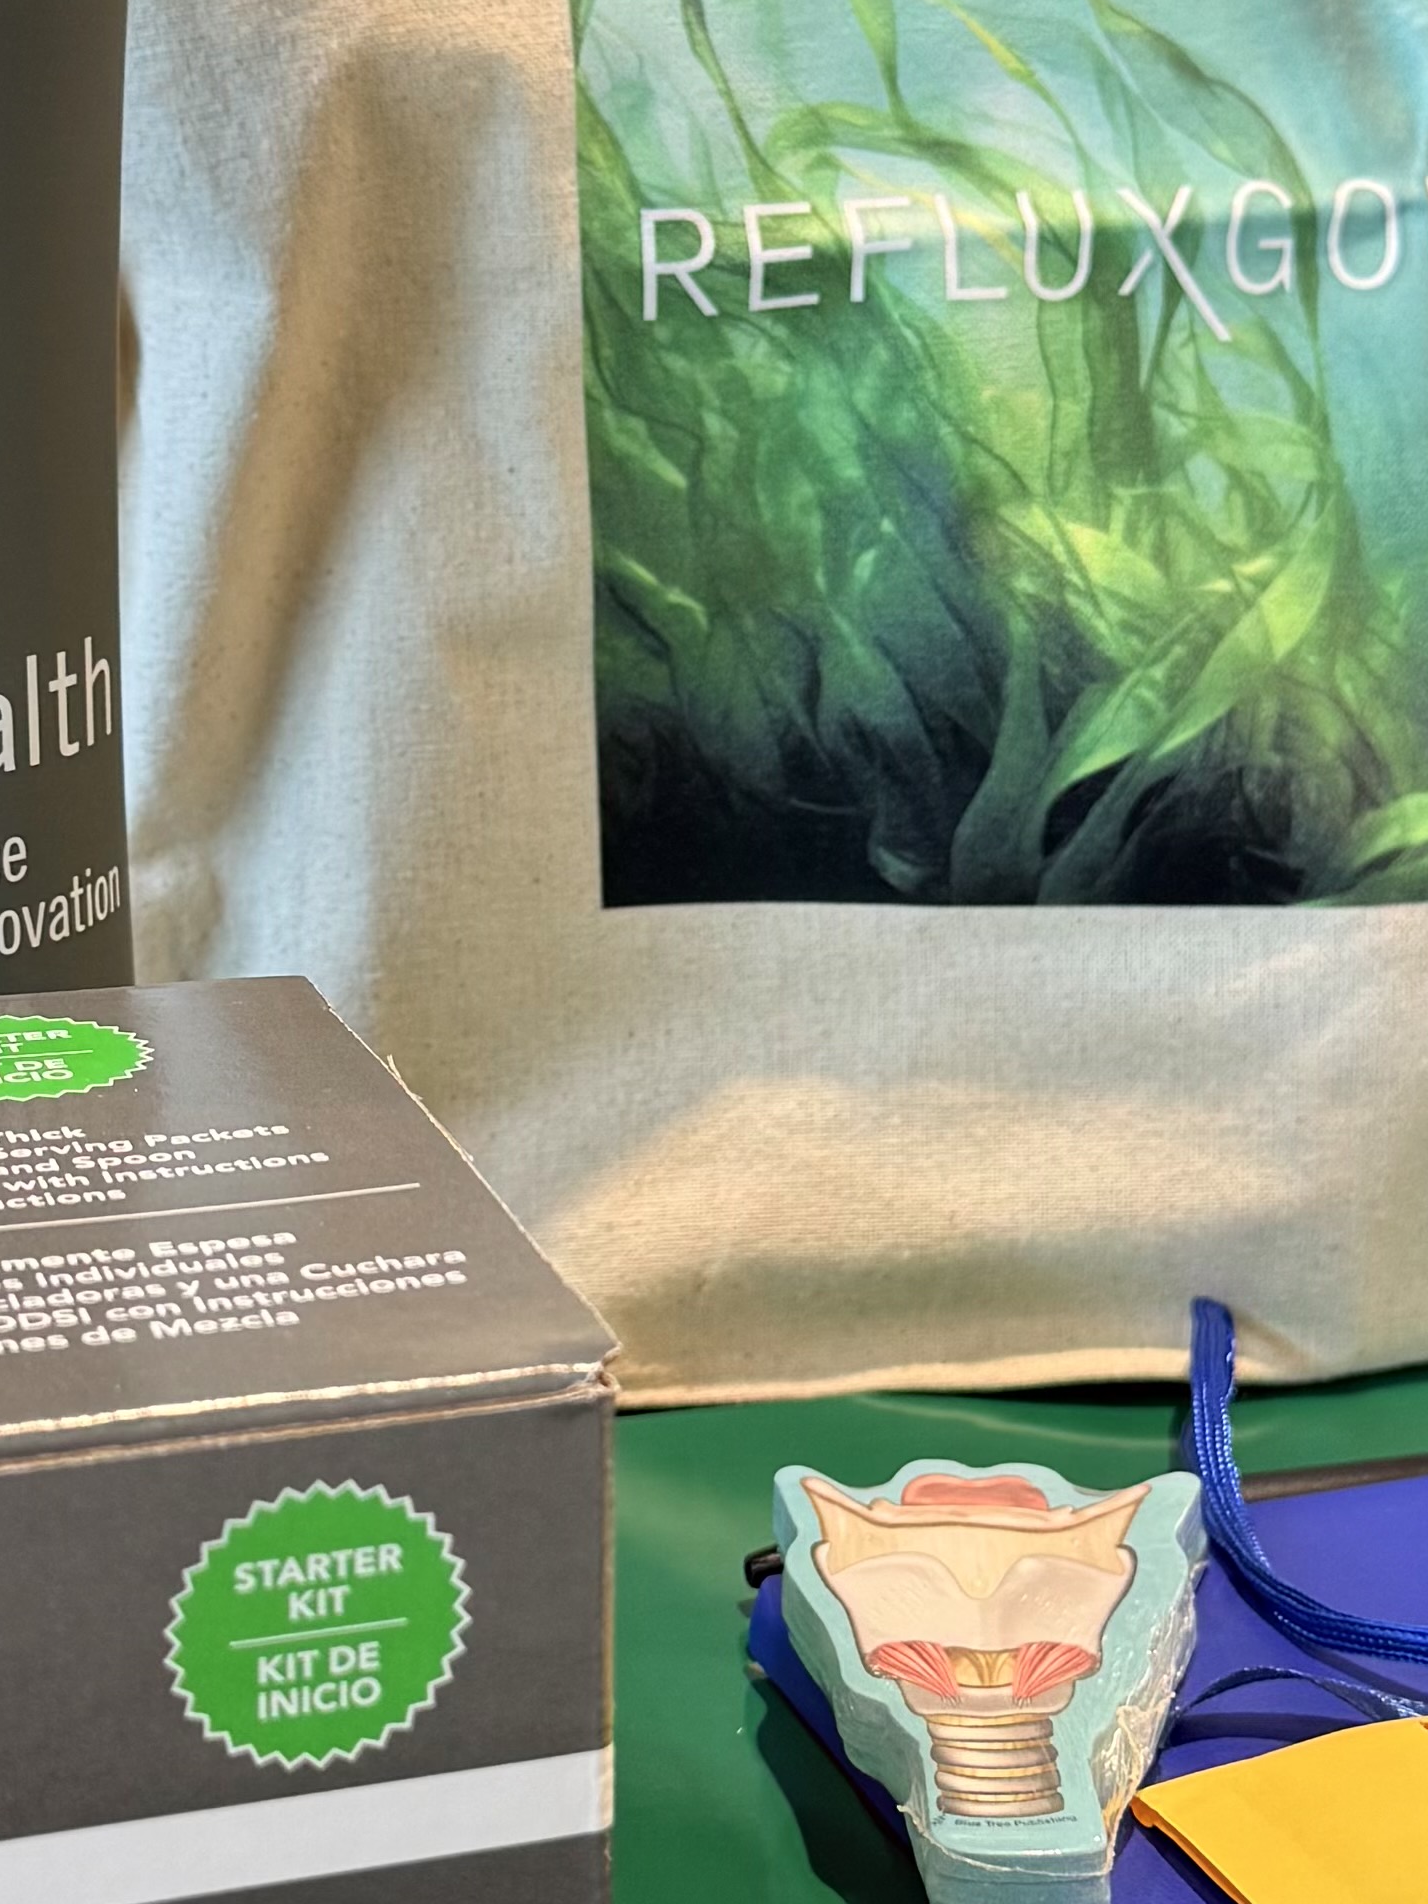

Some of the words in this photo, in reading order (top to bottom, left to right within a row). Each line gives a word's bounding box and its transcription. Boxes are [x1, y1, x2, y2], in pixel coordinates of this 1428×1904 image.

[14, 1057, 69, 1072] DE
[144, 1123, 290, 1147] Packets
[2, 1171, 90, 1192] with
[102, 1149, 330, 1184] Instructions
[71, 1148, 197, 1170] Spoon
[148, 1231, 297, 1259] Espesa
[34, 1250, 286, 1289] Individuales
[176, 1280, 201, 1298] y
[214, 1270, 291, 1291] una
[300, 1247, 467, 1281] Cuchara
[105, 1300, 183, 1322] con
[193, 1268, 468, 1313] Instrucciones
[80, 1325, 138, 1347] de
[149, 1307, 301, 1340] Mezcla
[233, 1542, 403, 1595] STARTER
[287, 1584, 351, 1622] KIT
[257, 1648, 320, 1686] KIT
[328, 1640, 381, 1676] DE
[256, 1675, 382, 1723] INICIO
